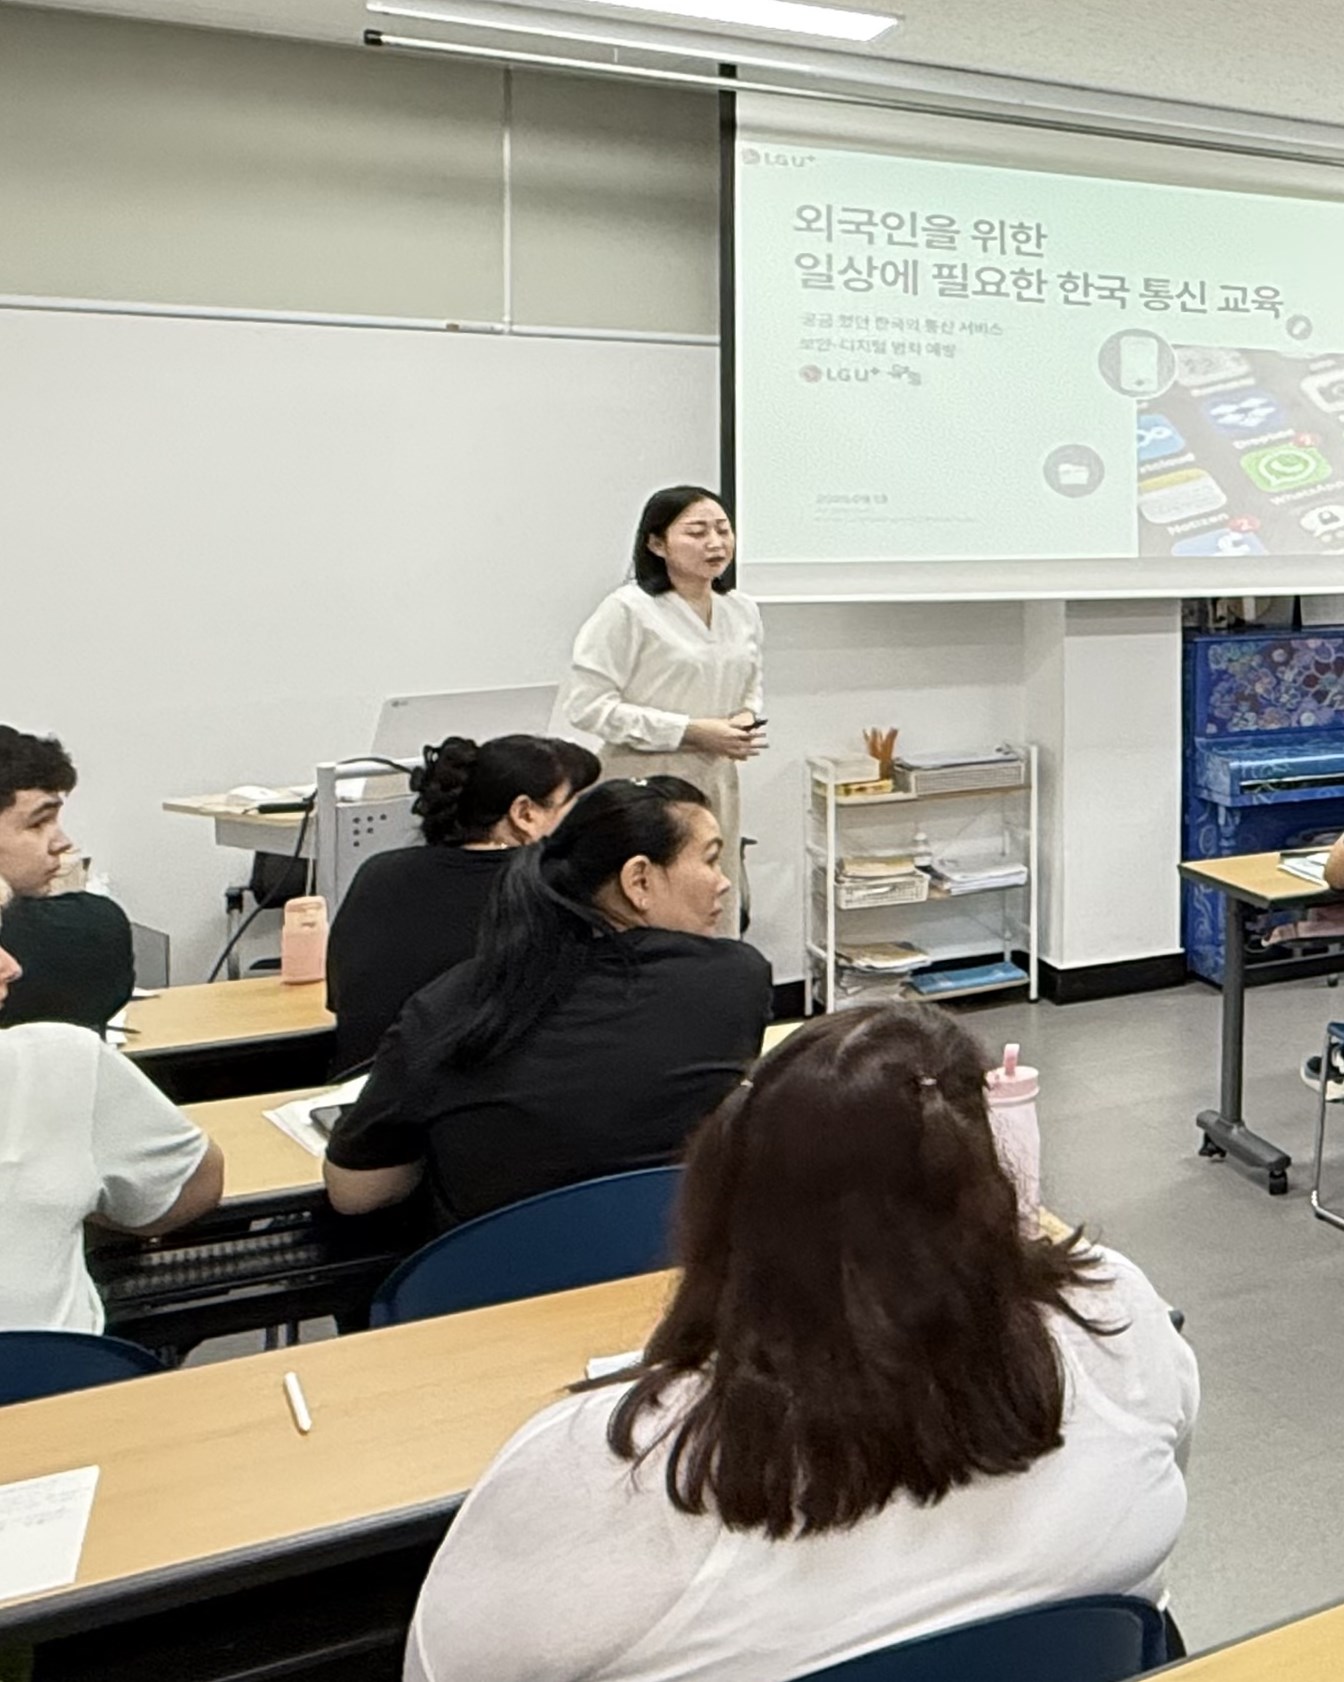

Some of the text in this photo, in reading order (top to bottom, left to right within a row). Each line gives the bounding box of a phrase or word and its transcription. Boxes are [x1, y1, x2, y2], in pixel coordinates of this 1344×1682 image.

[793, 203, 1049, 259] 외국인을 위한
[794, 252, 1285, 319] 일상에 필요한 한국 통신 교육
[958, 320, 1004, 336] 서비스
